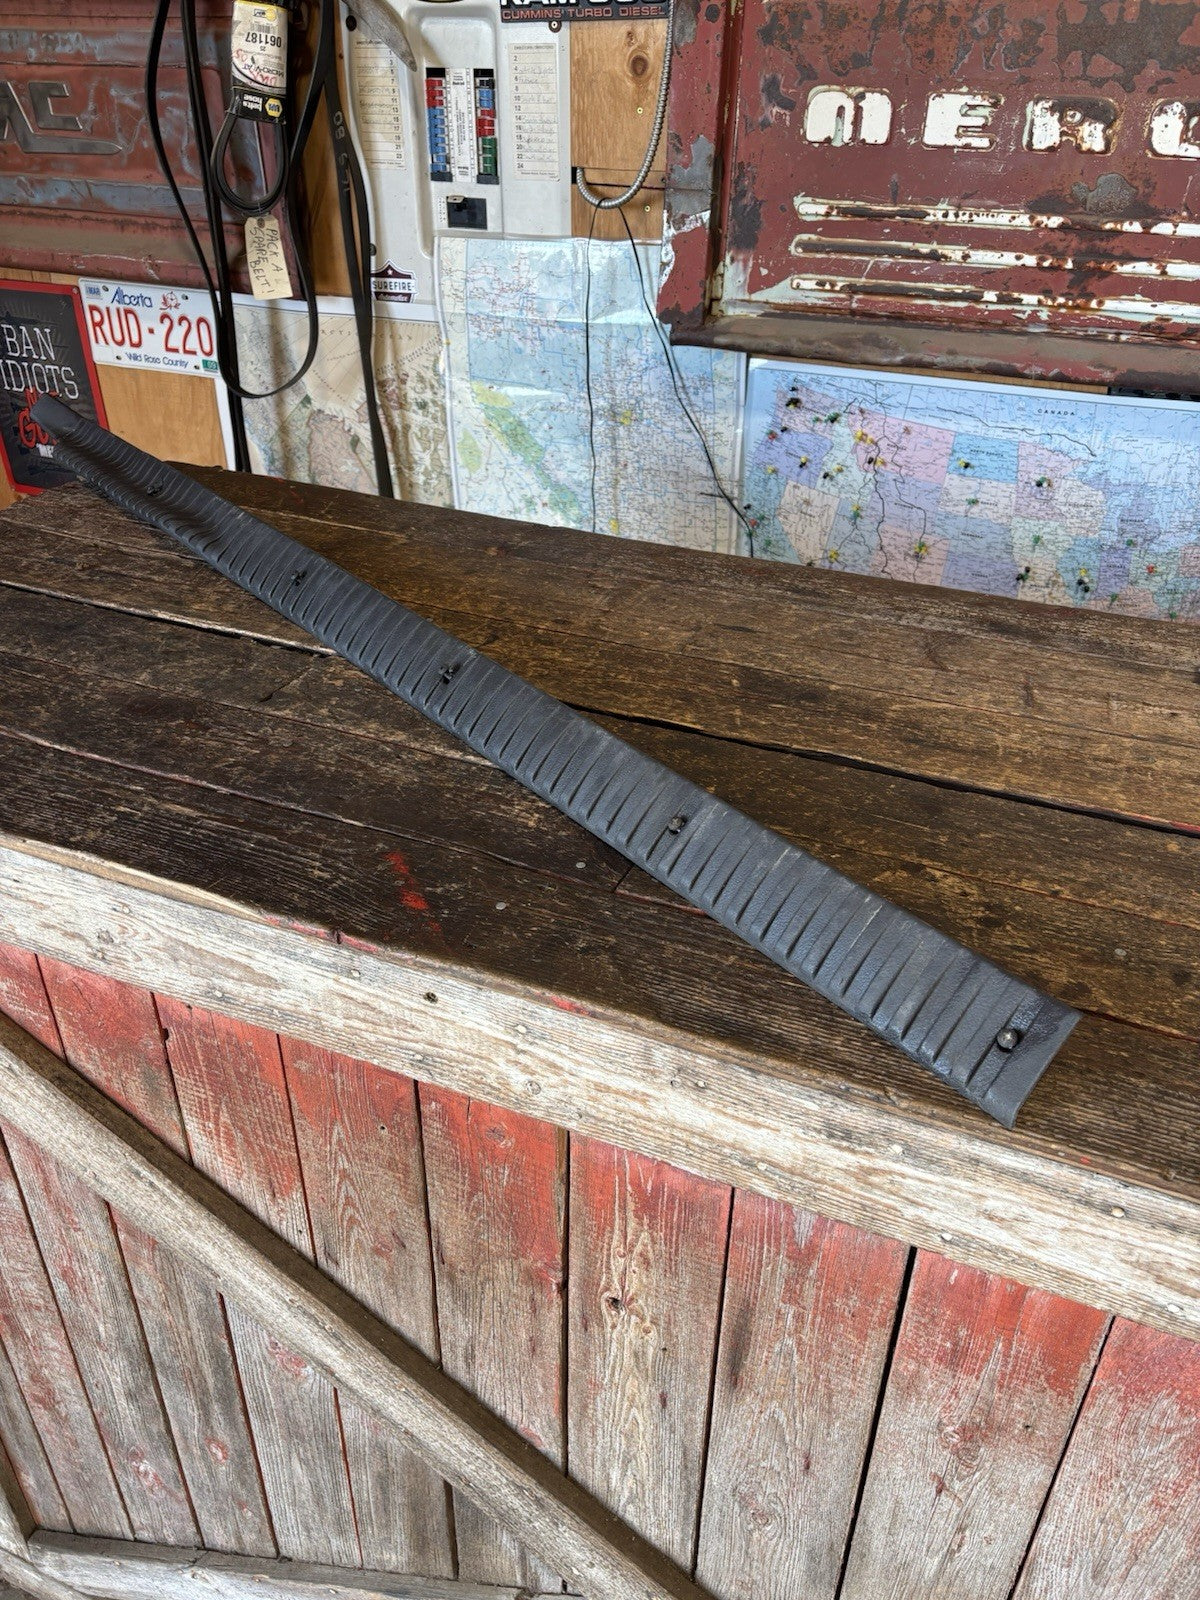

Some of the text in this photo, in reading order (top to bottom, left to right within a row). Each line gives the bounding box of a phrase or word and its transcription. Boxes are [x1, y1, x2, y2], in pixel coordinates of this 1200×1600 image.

[568, 7, 612, 17] TURBO
[619, 6, 665, 16] DIESEL
[245, 32, 282, 48] 061187
[249, 226, 269, 263] SPARE
[266, 228, 283, 272] PACK A
[111, 286, 153, 308] Alberta
[1, 324, 56, 361] BAN
[88, 305, 214, 357] RUD-220
[125, 352, 189, 369] Wild Rose Country
[0, 359, 79, 399] IDIOTS
[1037, 408, 1075, 416] CANADA
